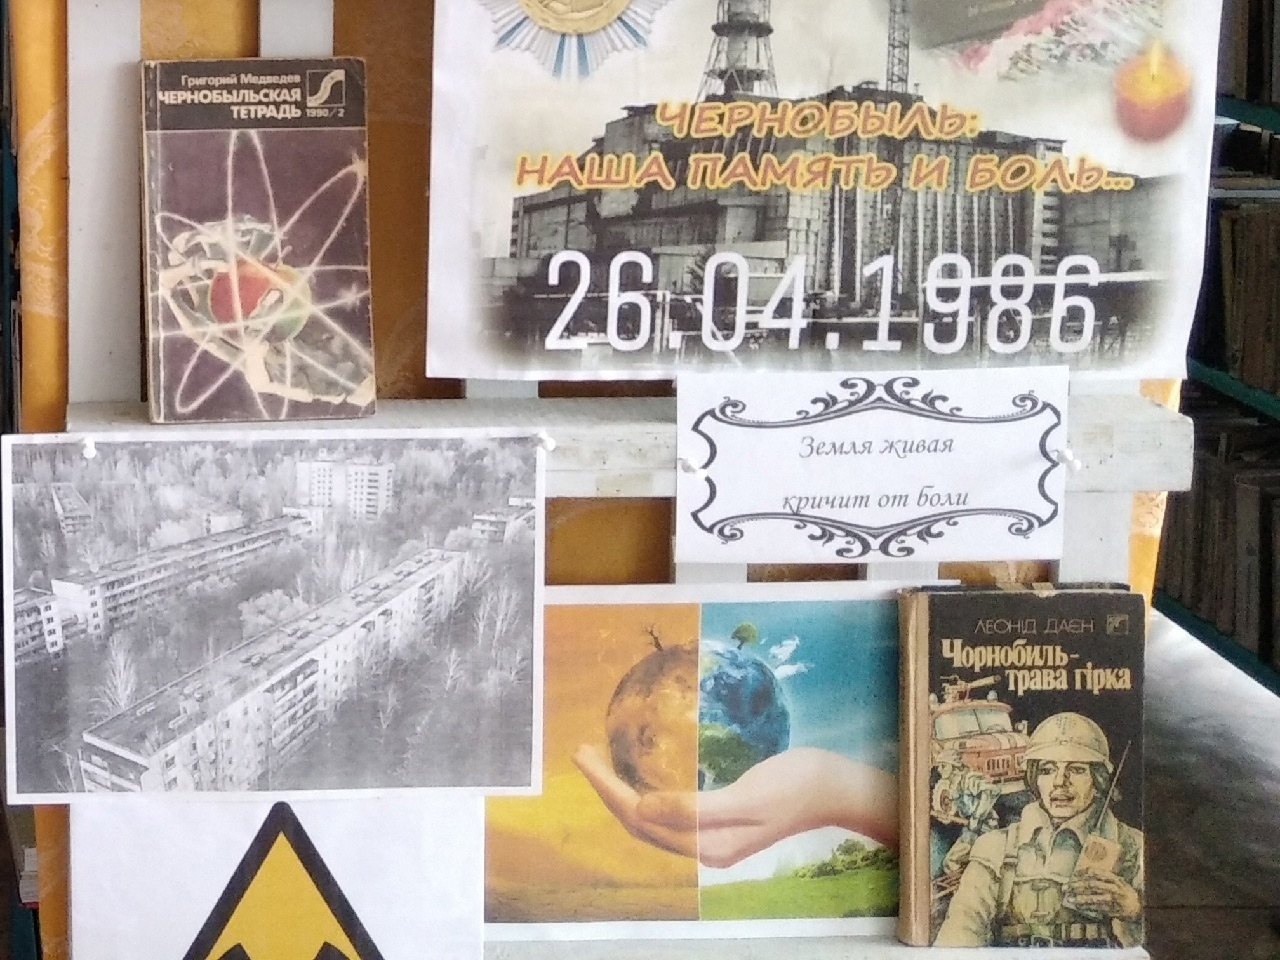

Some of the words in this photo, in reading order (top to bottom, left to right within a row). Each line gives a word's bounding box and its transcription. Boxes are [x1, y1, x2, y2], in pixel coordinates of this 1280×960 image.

[181, 74, 237, 88] Григорий
[240, 73, 301, 84] Медведев
[158, 88, 301, 104] ЧЕРНОБЫЛЬСКАЯ
[230, 104, 302, 119] ТЕТРАДЬ
[656, 100, 979, 139] ЧЕРНОБЫЛЬ:
[515, 155, 674, 188] НАША
[687, 153, 895, 191] ПАМЯТЬ
[910, 155, 954, 188] И
[544, 247, 1101, 355] 26.04.1986
[798, 434, 873, 460] Земля
[879, 435, 955, 458] живая
[782, 493, 870, 516] кричит
[877, 495, 909, 509] от
[916, 484, 970, 509] боли
[975, 619, 1036, 634] ЛЕОНІД
[1044, 619, 1094, 635] ДАЄН
[1005, 669, 1068, 695] трава
[1075, 662, 1132, 695] гірка
